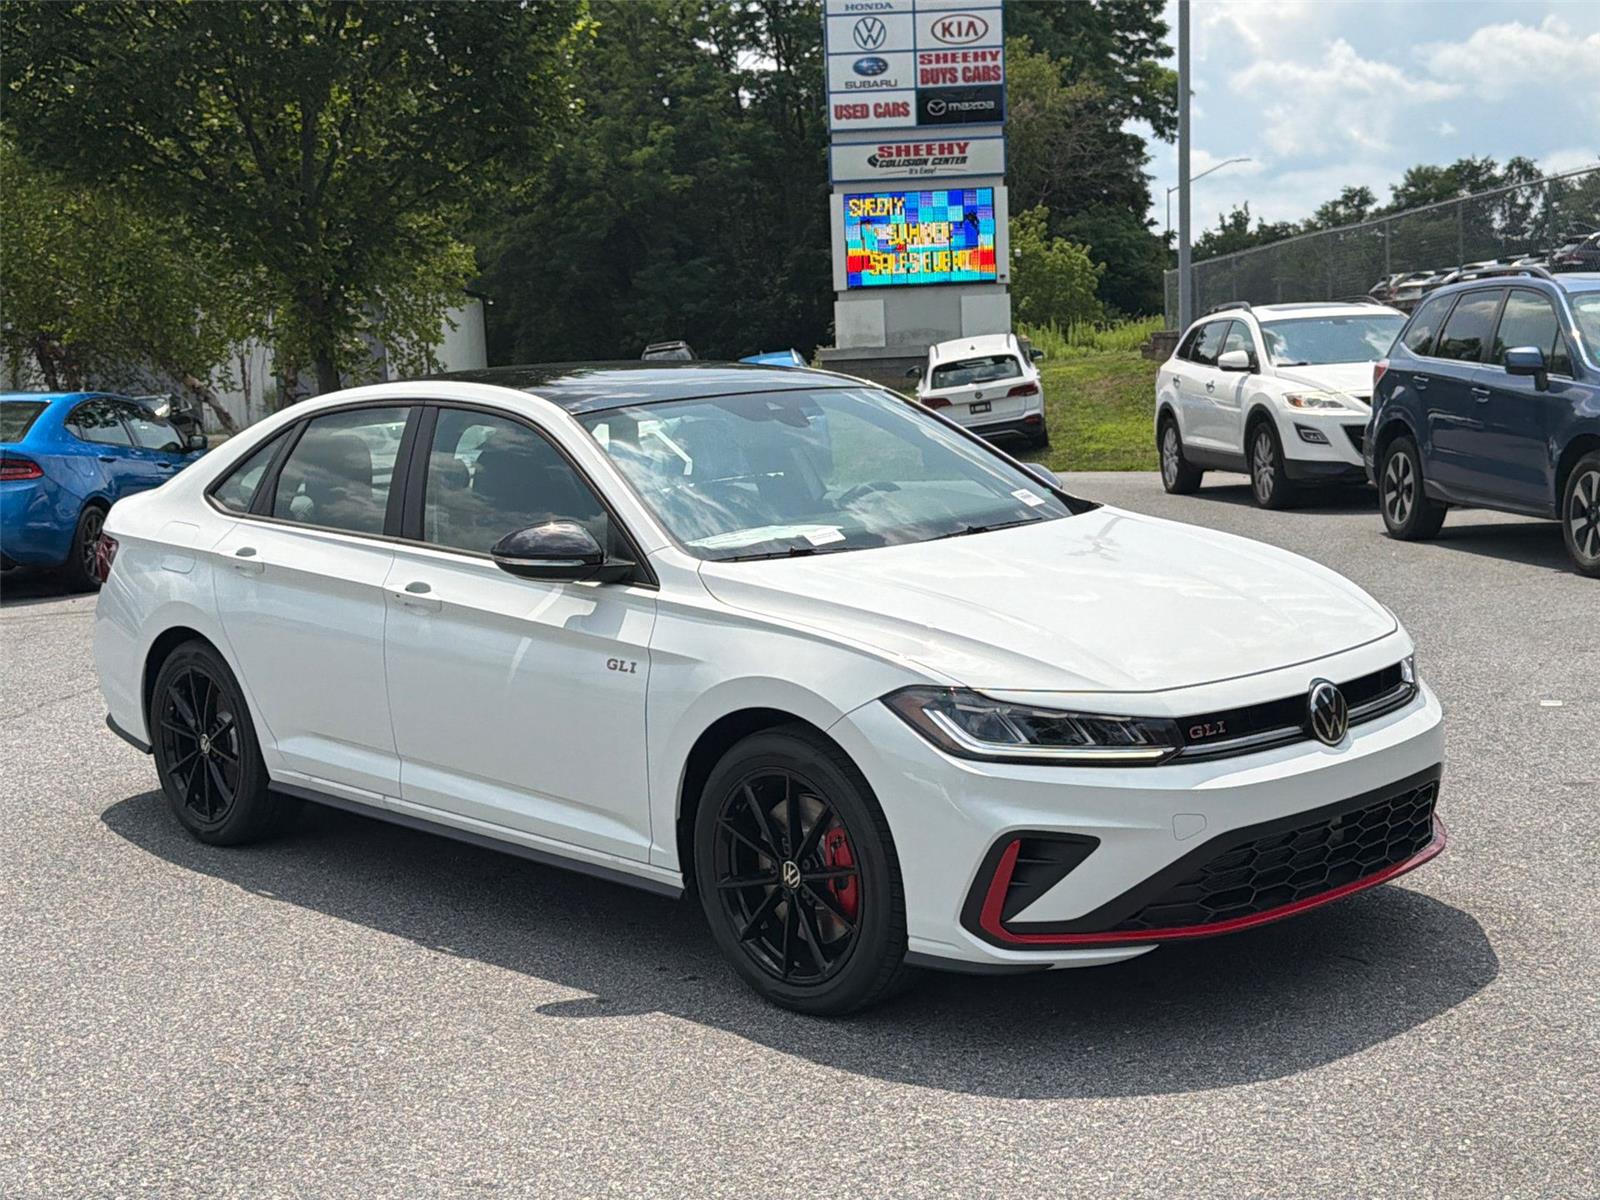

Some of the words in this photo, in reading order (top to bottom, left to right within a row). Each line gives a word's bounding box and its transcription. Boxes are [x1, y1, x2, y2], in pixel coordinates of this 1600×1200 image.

[845, 3, 893, 11] HONDA
[941, 20, 979, 38] KIA
[919, 51, 1000, 64] SHEEHY
[919, 67, 958, 86] BUYS
[961, 65, 1002, 84] CARS
[845, 80, 898, 89] SUBARU
[834, 103, 870, 120] USED
[873, 101, 911, 119] CARS
[878, 142, 970, 158] SHEEHY
[879, 158, 929, 168] COLLISION
[931, 156, 968, 165] CENTER
[606, 658, 637, 674] GLI
[1189, 720, 1226, 739] GLI
